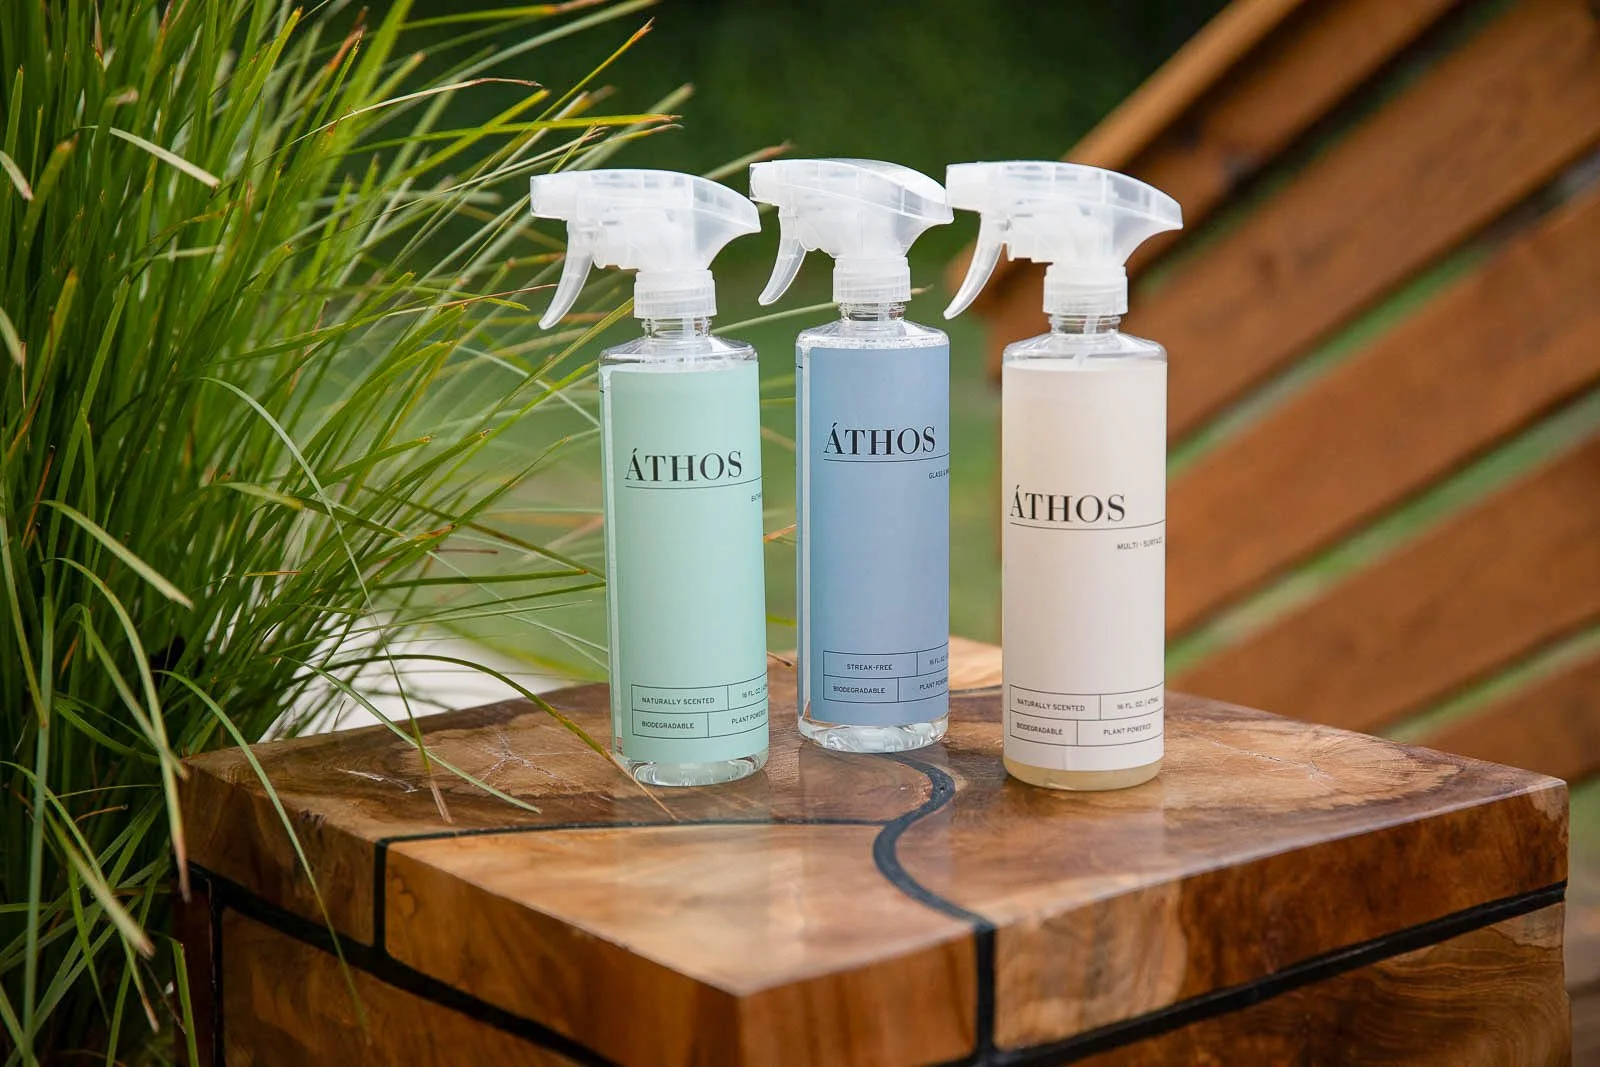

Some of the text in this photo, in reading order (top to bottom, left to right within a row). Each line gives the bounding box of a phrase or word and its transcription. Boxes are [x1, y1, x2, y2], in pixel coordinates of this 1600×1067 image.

[823, 422, 936, 456] ÁTHOS
[624, 448, 743, 482] ÁTHOS
[1010, 484, 1126, 523] ÁTHOS
[846, 663, 894, 671] STREAK-FREE
[833, 685, 886, 694] BIODEGRADABLE
[919, 681, 935, 690] PLANT
[641, 697, 715, 705] NATURALLY SCENTED
[1016, 697, 1086, 712] NATURALLY SCENTED
[641, 721, 695, 729] BIODEGRADABLE
[731, 715, 750, 725] PLANT
[1016, 722, 1063, 735] BIODEGRADABLE
[1103, 722, 1152, 736] PLANT POWERED
